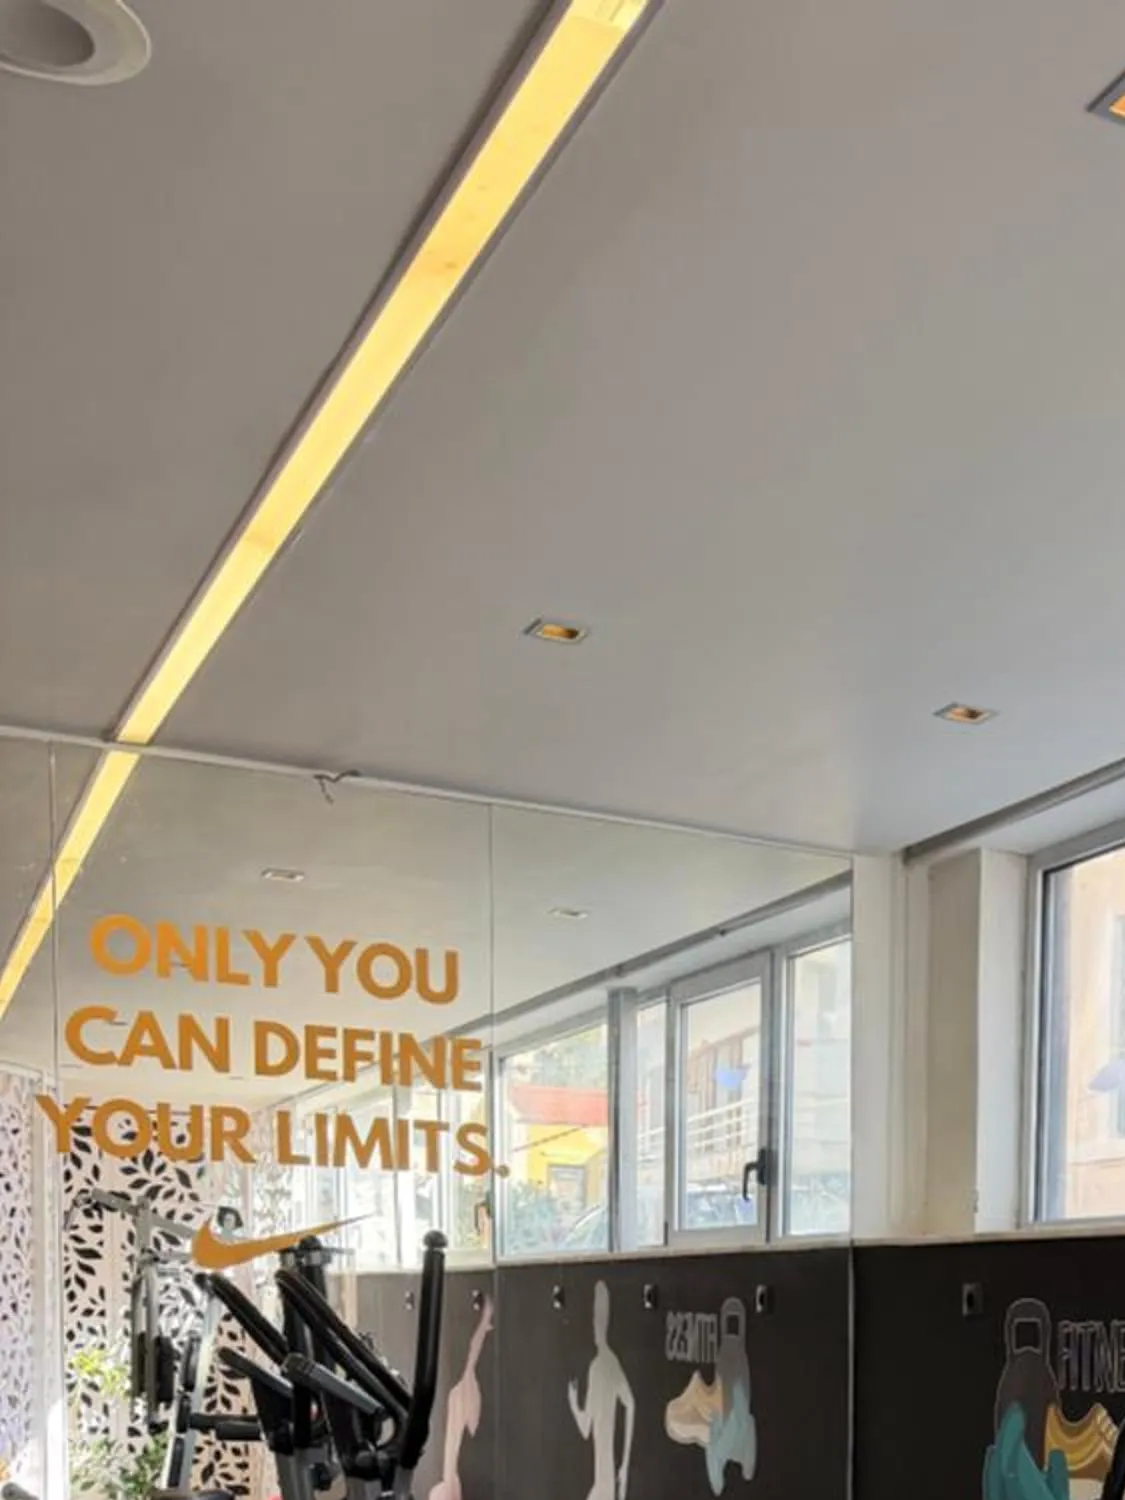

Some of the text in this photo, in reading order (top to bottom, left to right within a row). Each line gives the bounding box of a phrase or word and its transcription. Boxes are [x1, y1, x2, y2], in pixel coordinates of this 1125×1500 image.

[89, 914, 459, 1005] ONLY YOU
[64, 1006, 483, 1092] CAN DEFINE
[35, 1094, 510, 1178] YOUR LIMITS.
